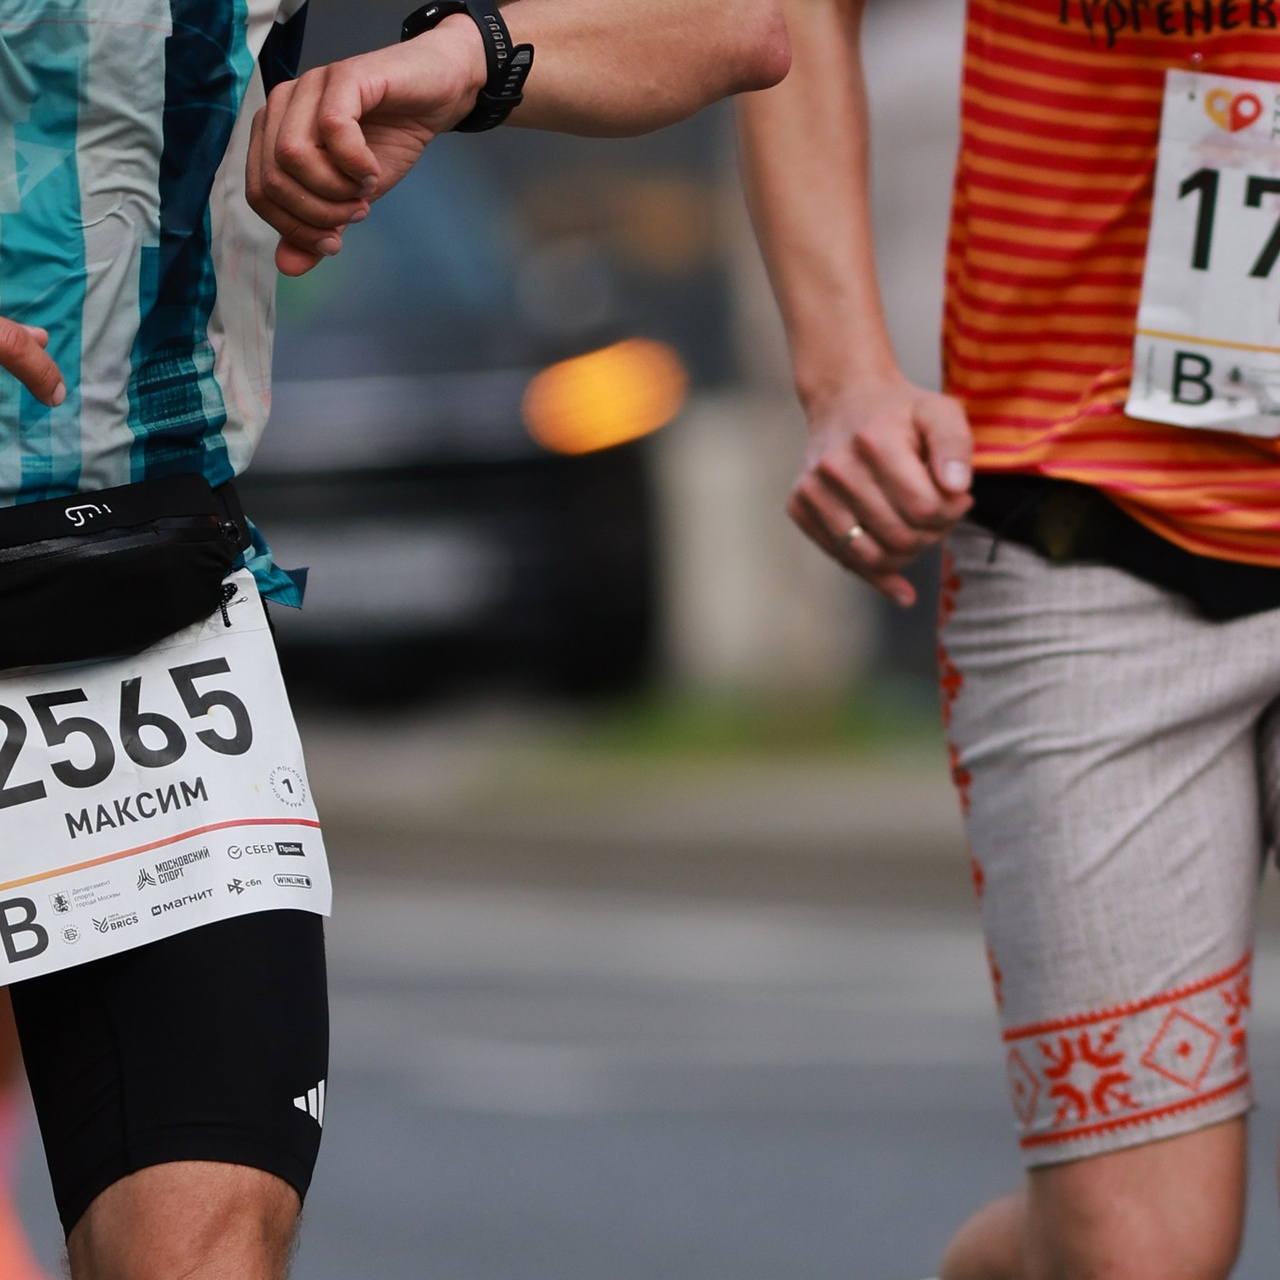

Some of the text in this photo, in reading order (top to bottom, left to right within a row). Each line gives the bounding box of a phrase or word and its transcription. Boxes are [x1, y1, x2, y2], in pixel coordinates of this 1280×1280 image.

[281, 778, 294, 794] 1
[64, 776, 209, 840] МАКСИМ
[244, 844, 274, 855] СБЕР
[154, 845, 211, 874] МОСКОВСКИЙ
[158, 866, 185, 885] СПОРТ
[276, 876, 305, 885] WINLINE
[71, 879, 111, 896] Департамент
[110, 915, 139, 931] BRICS
